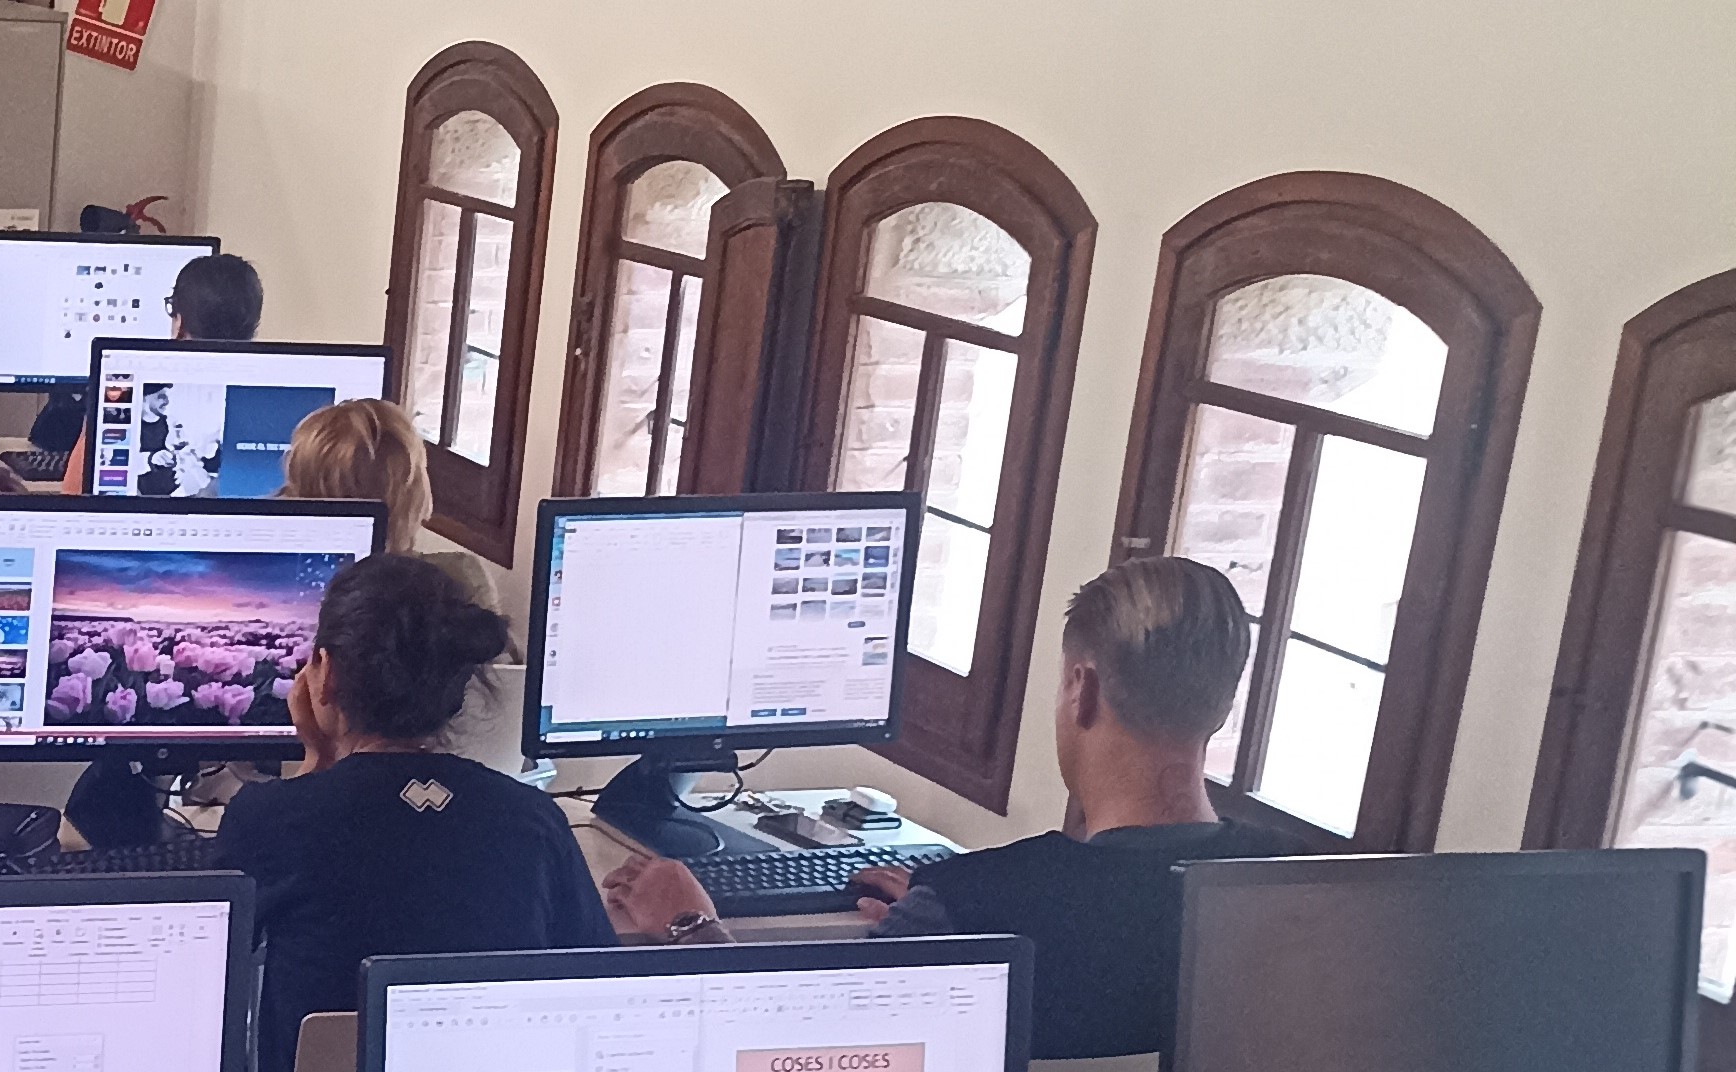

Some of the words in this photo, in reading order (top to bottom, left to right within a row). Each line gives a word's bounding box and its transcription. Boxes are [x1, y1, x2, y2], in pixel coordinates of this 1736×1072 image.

[70, 26, 137, 62] EXTINTOR
[770, 1055, 824, 1072] COSES
[837, 1052, 891, 1070] COSES
